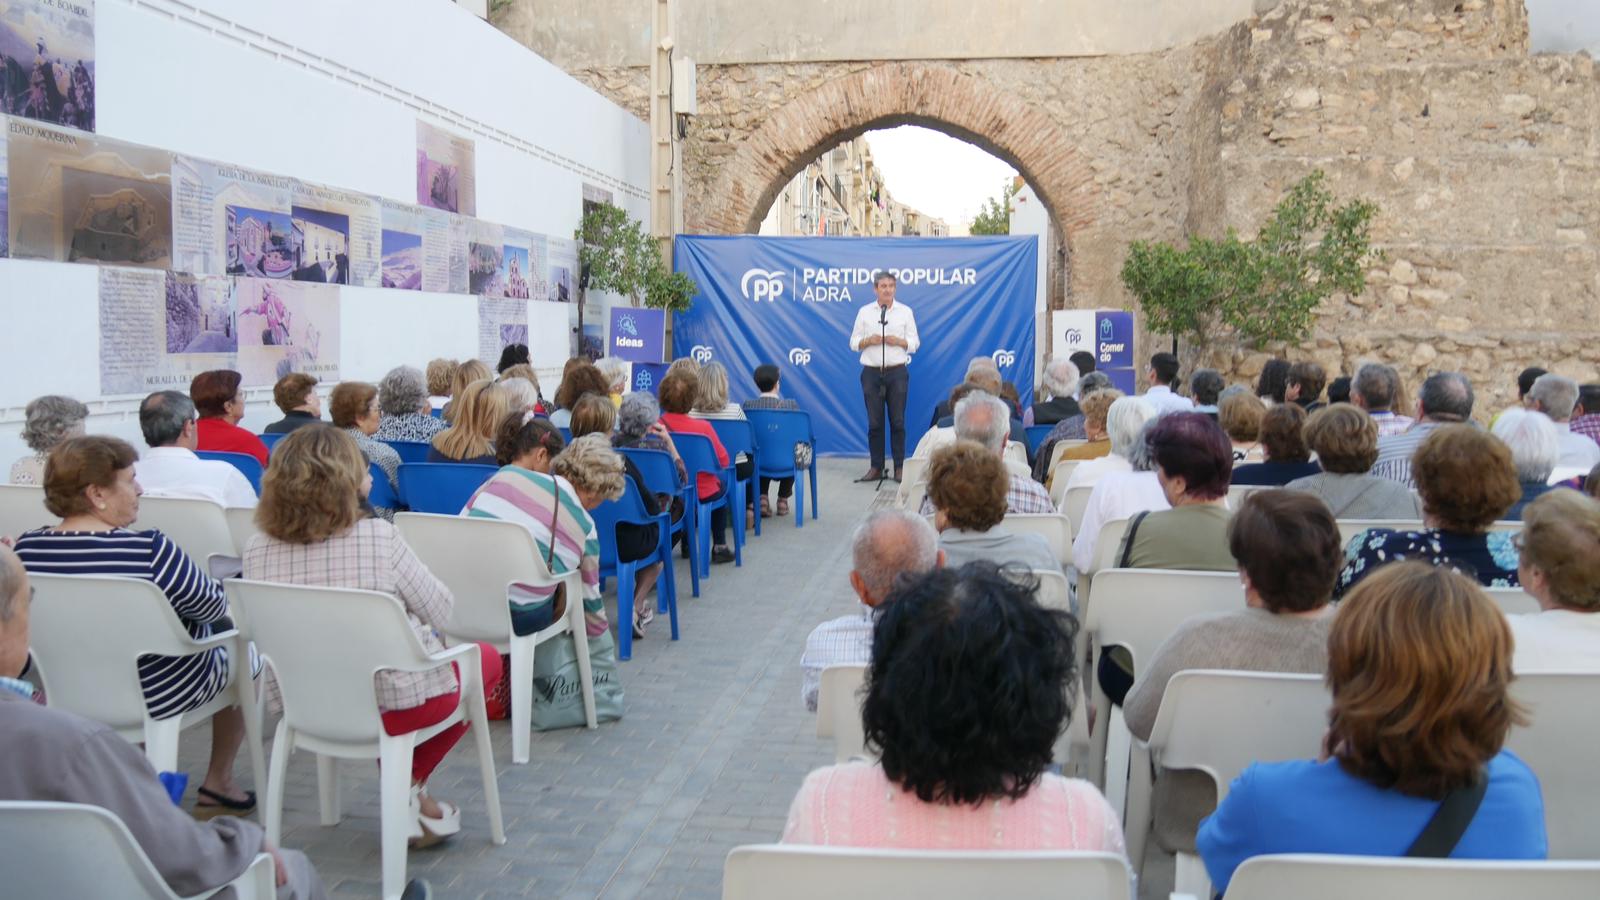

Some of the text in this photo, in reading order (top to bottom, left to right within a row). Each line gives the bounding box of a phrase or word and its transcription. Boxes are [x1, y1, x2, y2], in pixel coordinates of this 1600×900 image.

[10, 123, 77, 145] EDAD MODERNA
[803, 286, 852, 302] ADRA
[616, 335, 644, 348] Ideas
[1099, 342, 1124, 353] Comer
[145, 375, 178, 385] MURALLA
[545, 671, 609, 704] Patria
